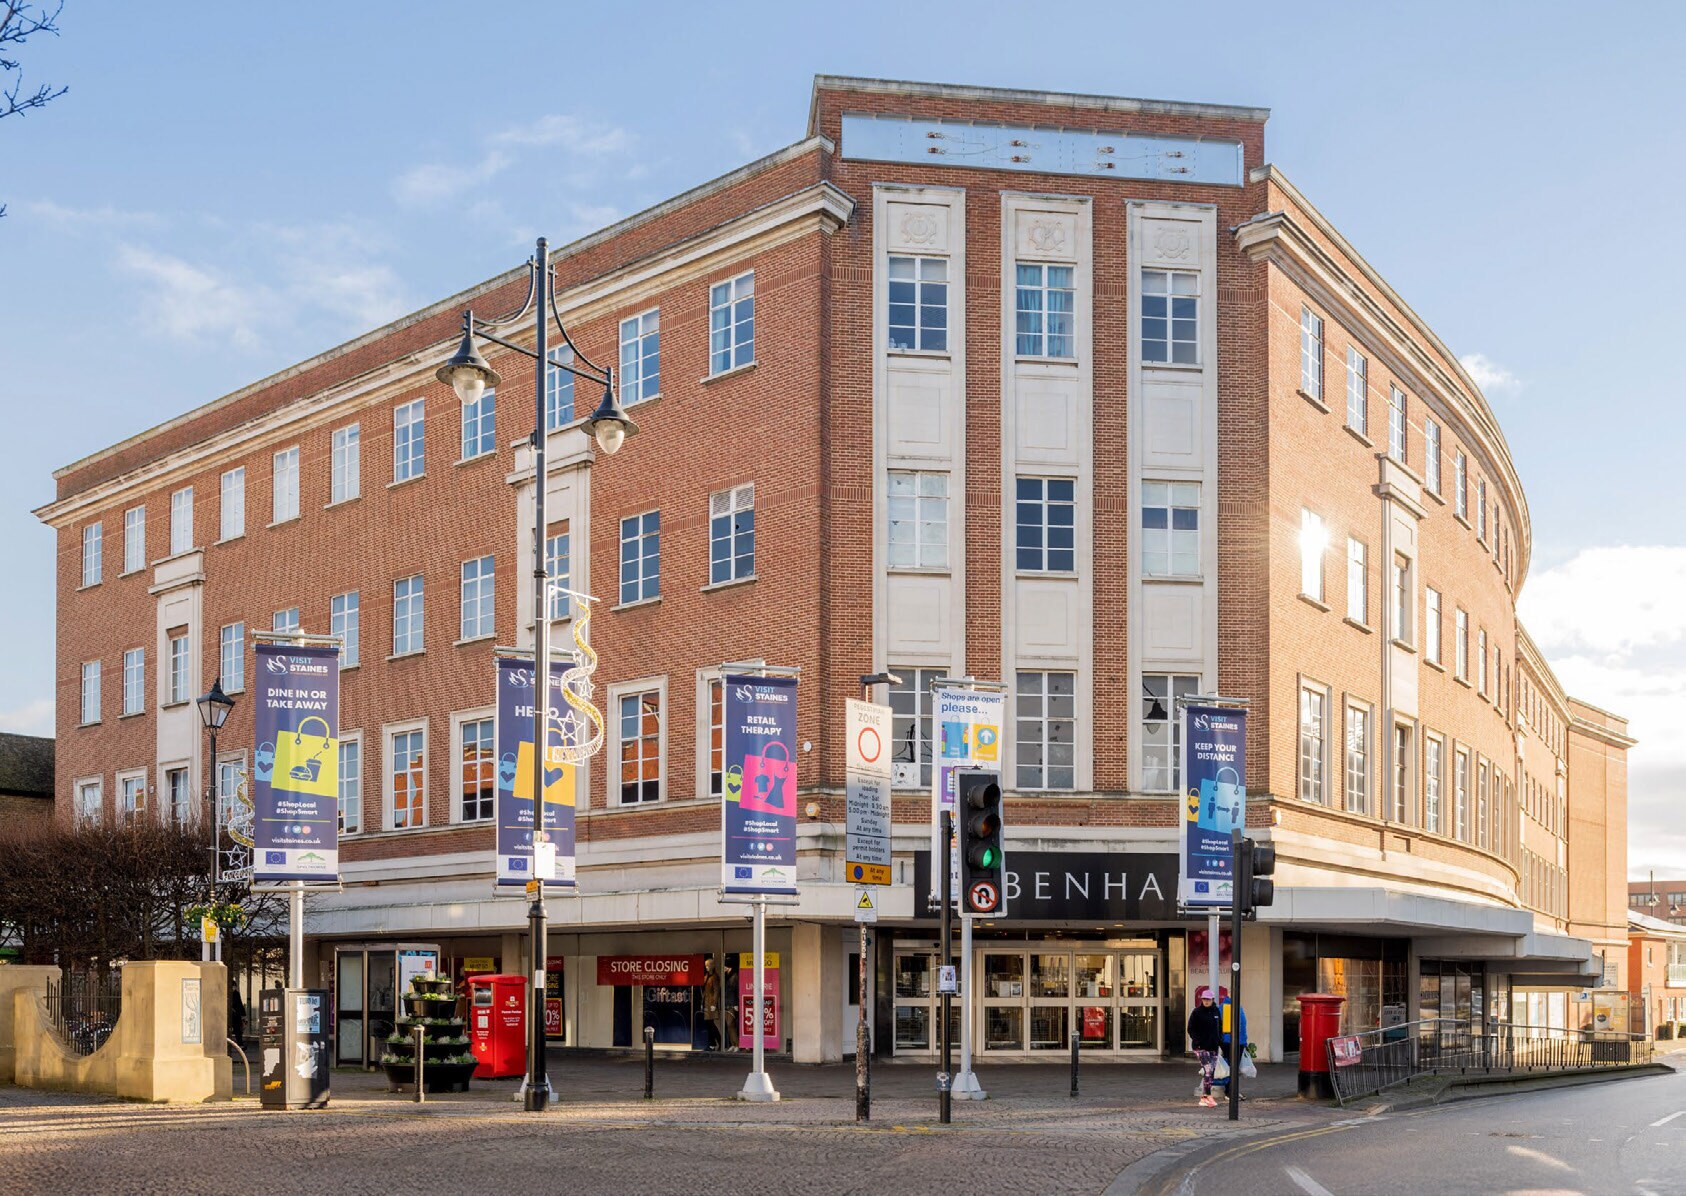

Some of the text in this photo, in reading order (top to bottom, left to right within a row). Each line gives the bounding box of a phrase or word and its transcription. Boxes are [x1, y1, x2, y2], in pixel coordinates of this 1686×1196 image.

[289, 656, 313, 664] VISIT
[289, 664, 329, 673] STAINES
[267, 688, 327, 699] DINE IN OR
[755, 693, 789, 701] STAINES
[941, 692, 965, 701] Shops
[266, 700, 328, 710] TAKE AWAY
[941, 703, 988, 714] please...
[515, 705, 559, 719] HEO
[747, 715, 776, 725] RETAIL
[858, 713, 881, 725] ZONE
[741, 726, 782, 735] THERAPY
[1210, 722, 1238, 730] STAINES
[1194, 743, 1237, 752] KEEP YOUR
[1197, 752, 1235, 761] DISTANCE
[849, 800, 869, 808] Midnight
[861, 818, 878, 826] Sunday
[857, 837, 873, 845] Except
[611, 960, 689, 973] STORE CLOSING
